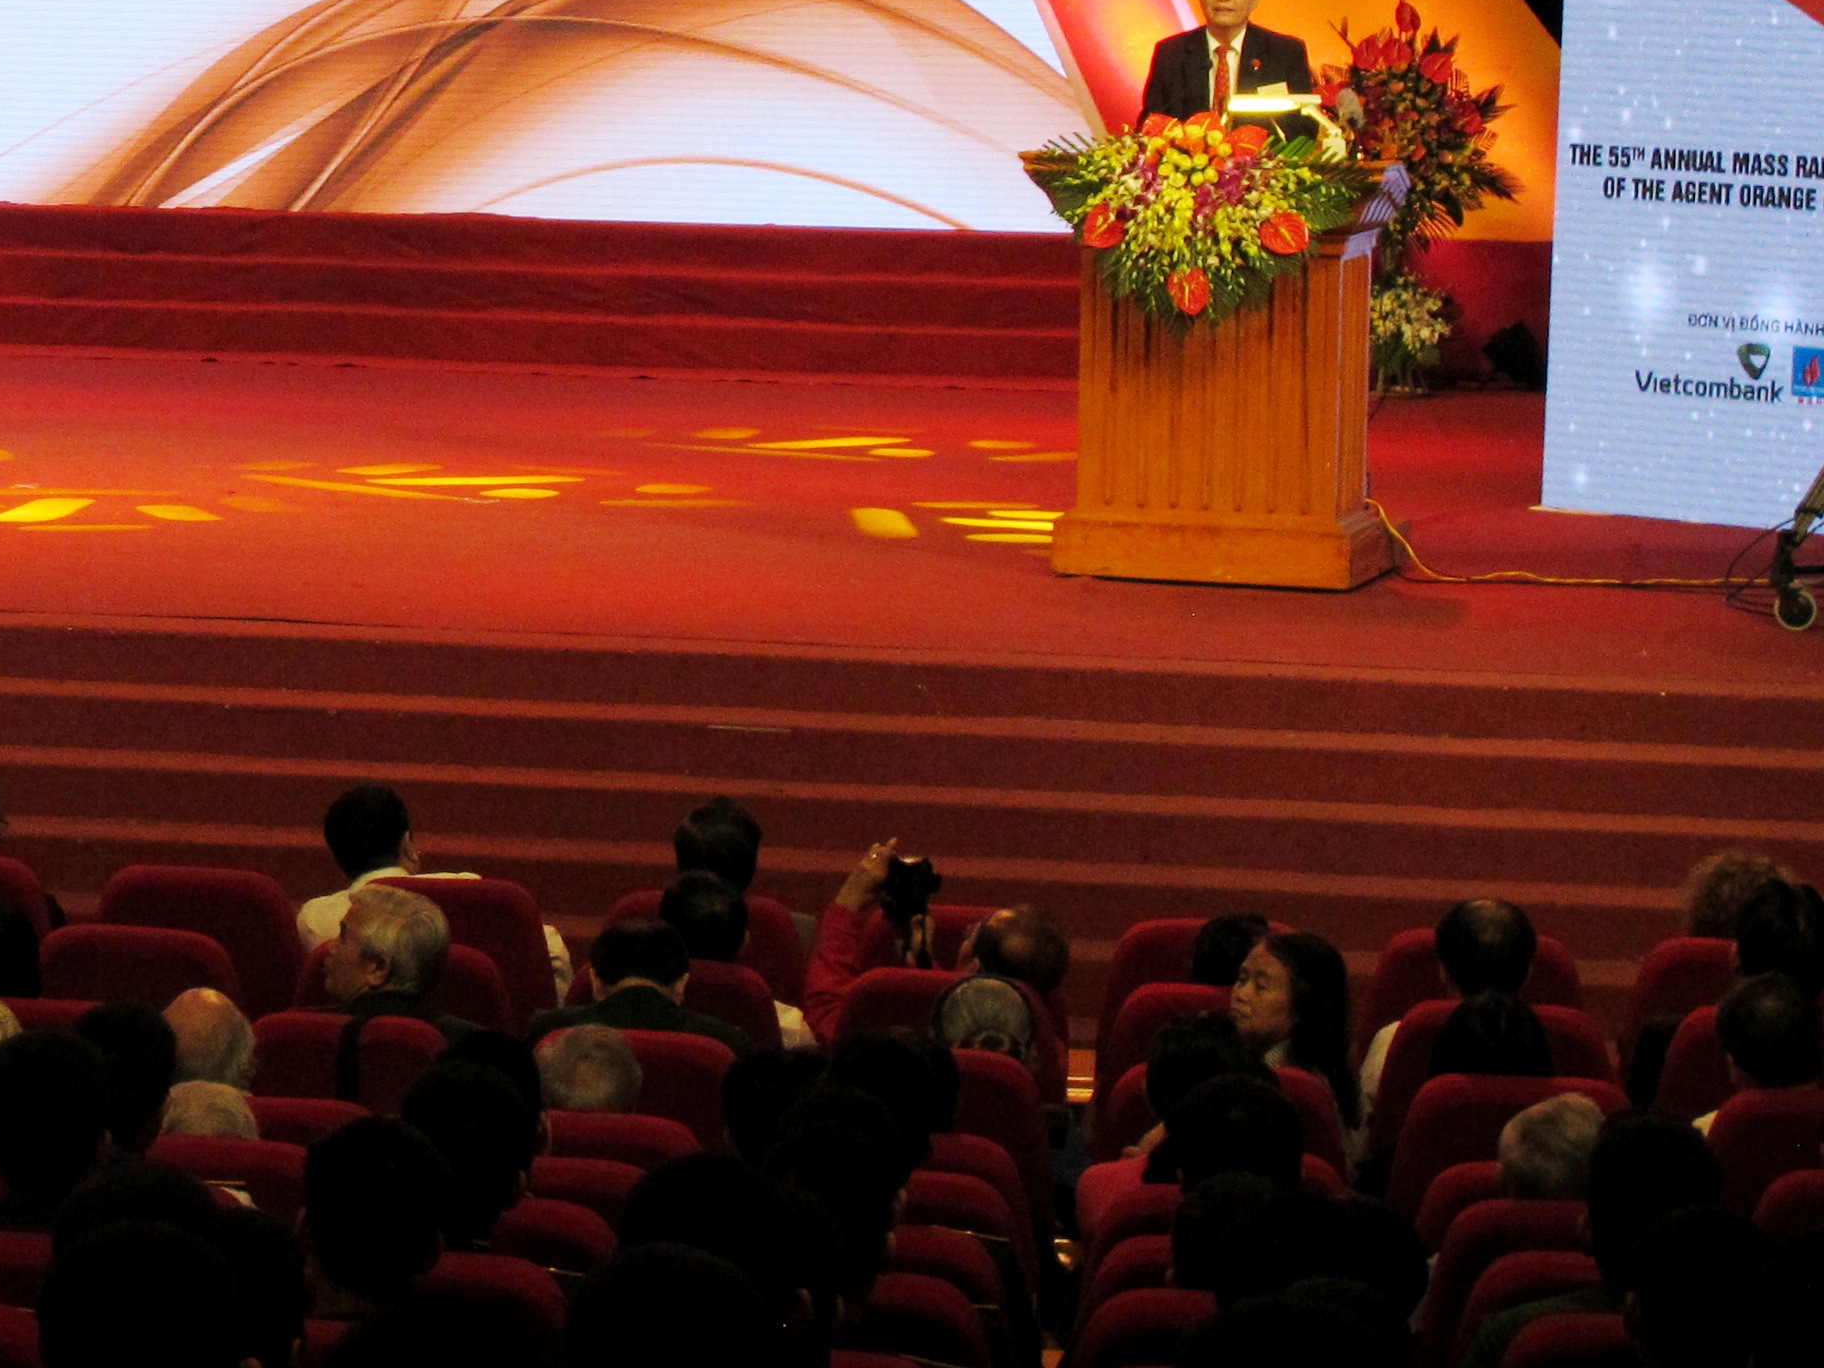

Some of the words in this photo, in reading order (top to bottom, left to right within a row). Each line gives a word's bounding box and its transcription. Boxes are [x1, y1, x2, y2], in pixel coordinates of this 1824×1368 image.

[1570, 143, 1602, 166] THE
[1651, 148, 1726, 173] ANNUAL
[1733, 152, 1788, 176] MASS
[1603, 176, 1626, 199] OF
[1632, 178, 1665, 201] THE
[1672, 181, 1733, 205] AGENT
[1740, 184, 1817, 210] ORANGE
[1635, 370, 1784, 403] Vietcombank
